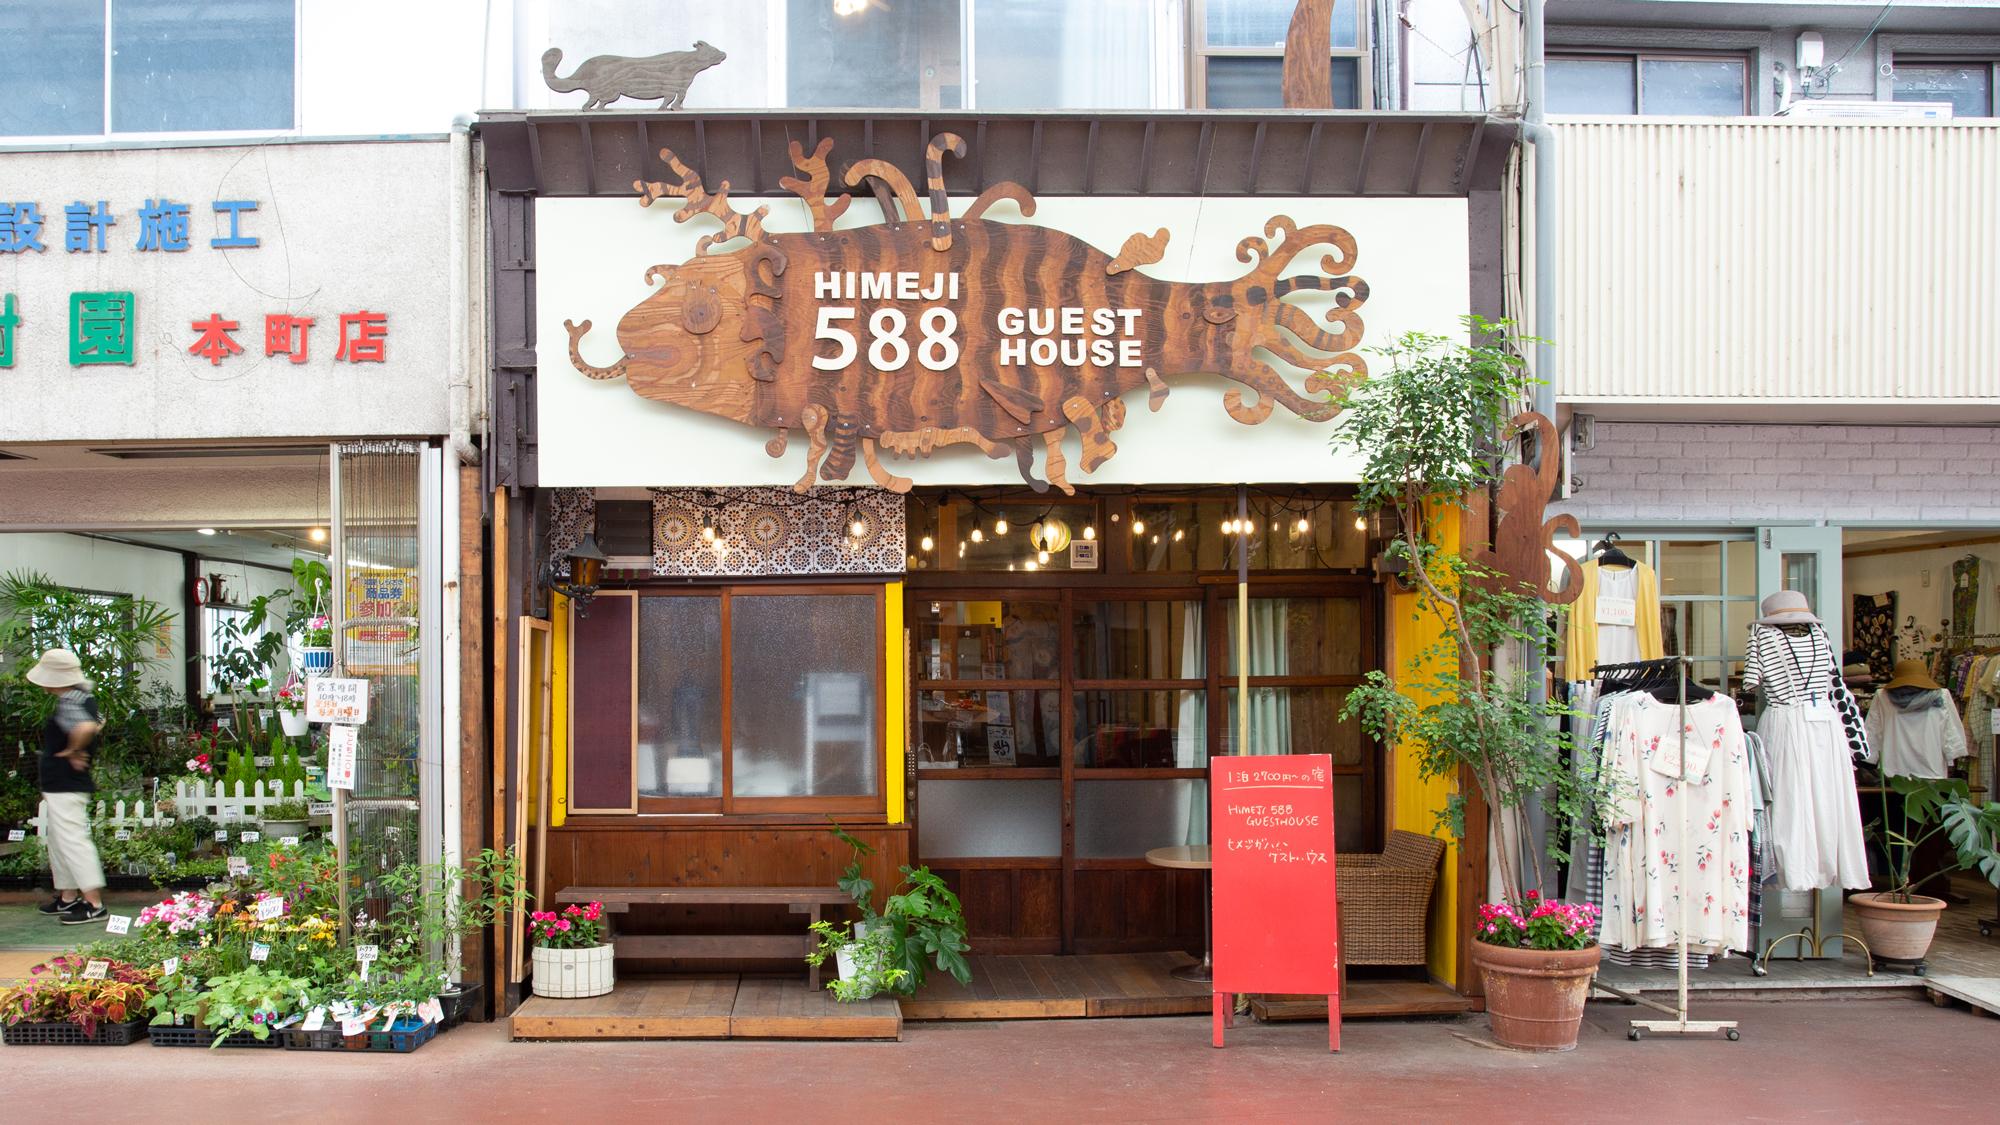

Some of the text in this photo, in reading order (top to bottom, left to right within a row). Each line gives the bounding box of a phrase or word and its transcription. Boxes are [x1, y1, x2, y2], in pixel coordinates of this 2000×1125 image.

[0, 199, 260, 253] 設計施工
[814, 271, 960, 301] HIMEJI
[0, 290, 389, 367] 園 本町店
[997, 307, 1143, 336] GUEST
[811, 306, 960, 371] 588
[1000, 338, 1143, 367] HOUSE
[358, 600, 409, 618] 参加
[316, 681, 358, 693] 営業時間
[1246, 815, 1320, 828] GUESTHOUSE
[1270, 804, 1294, 815] 588
